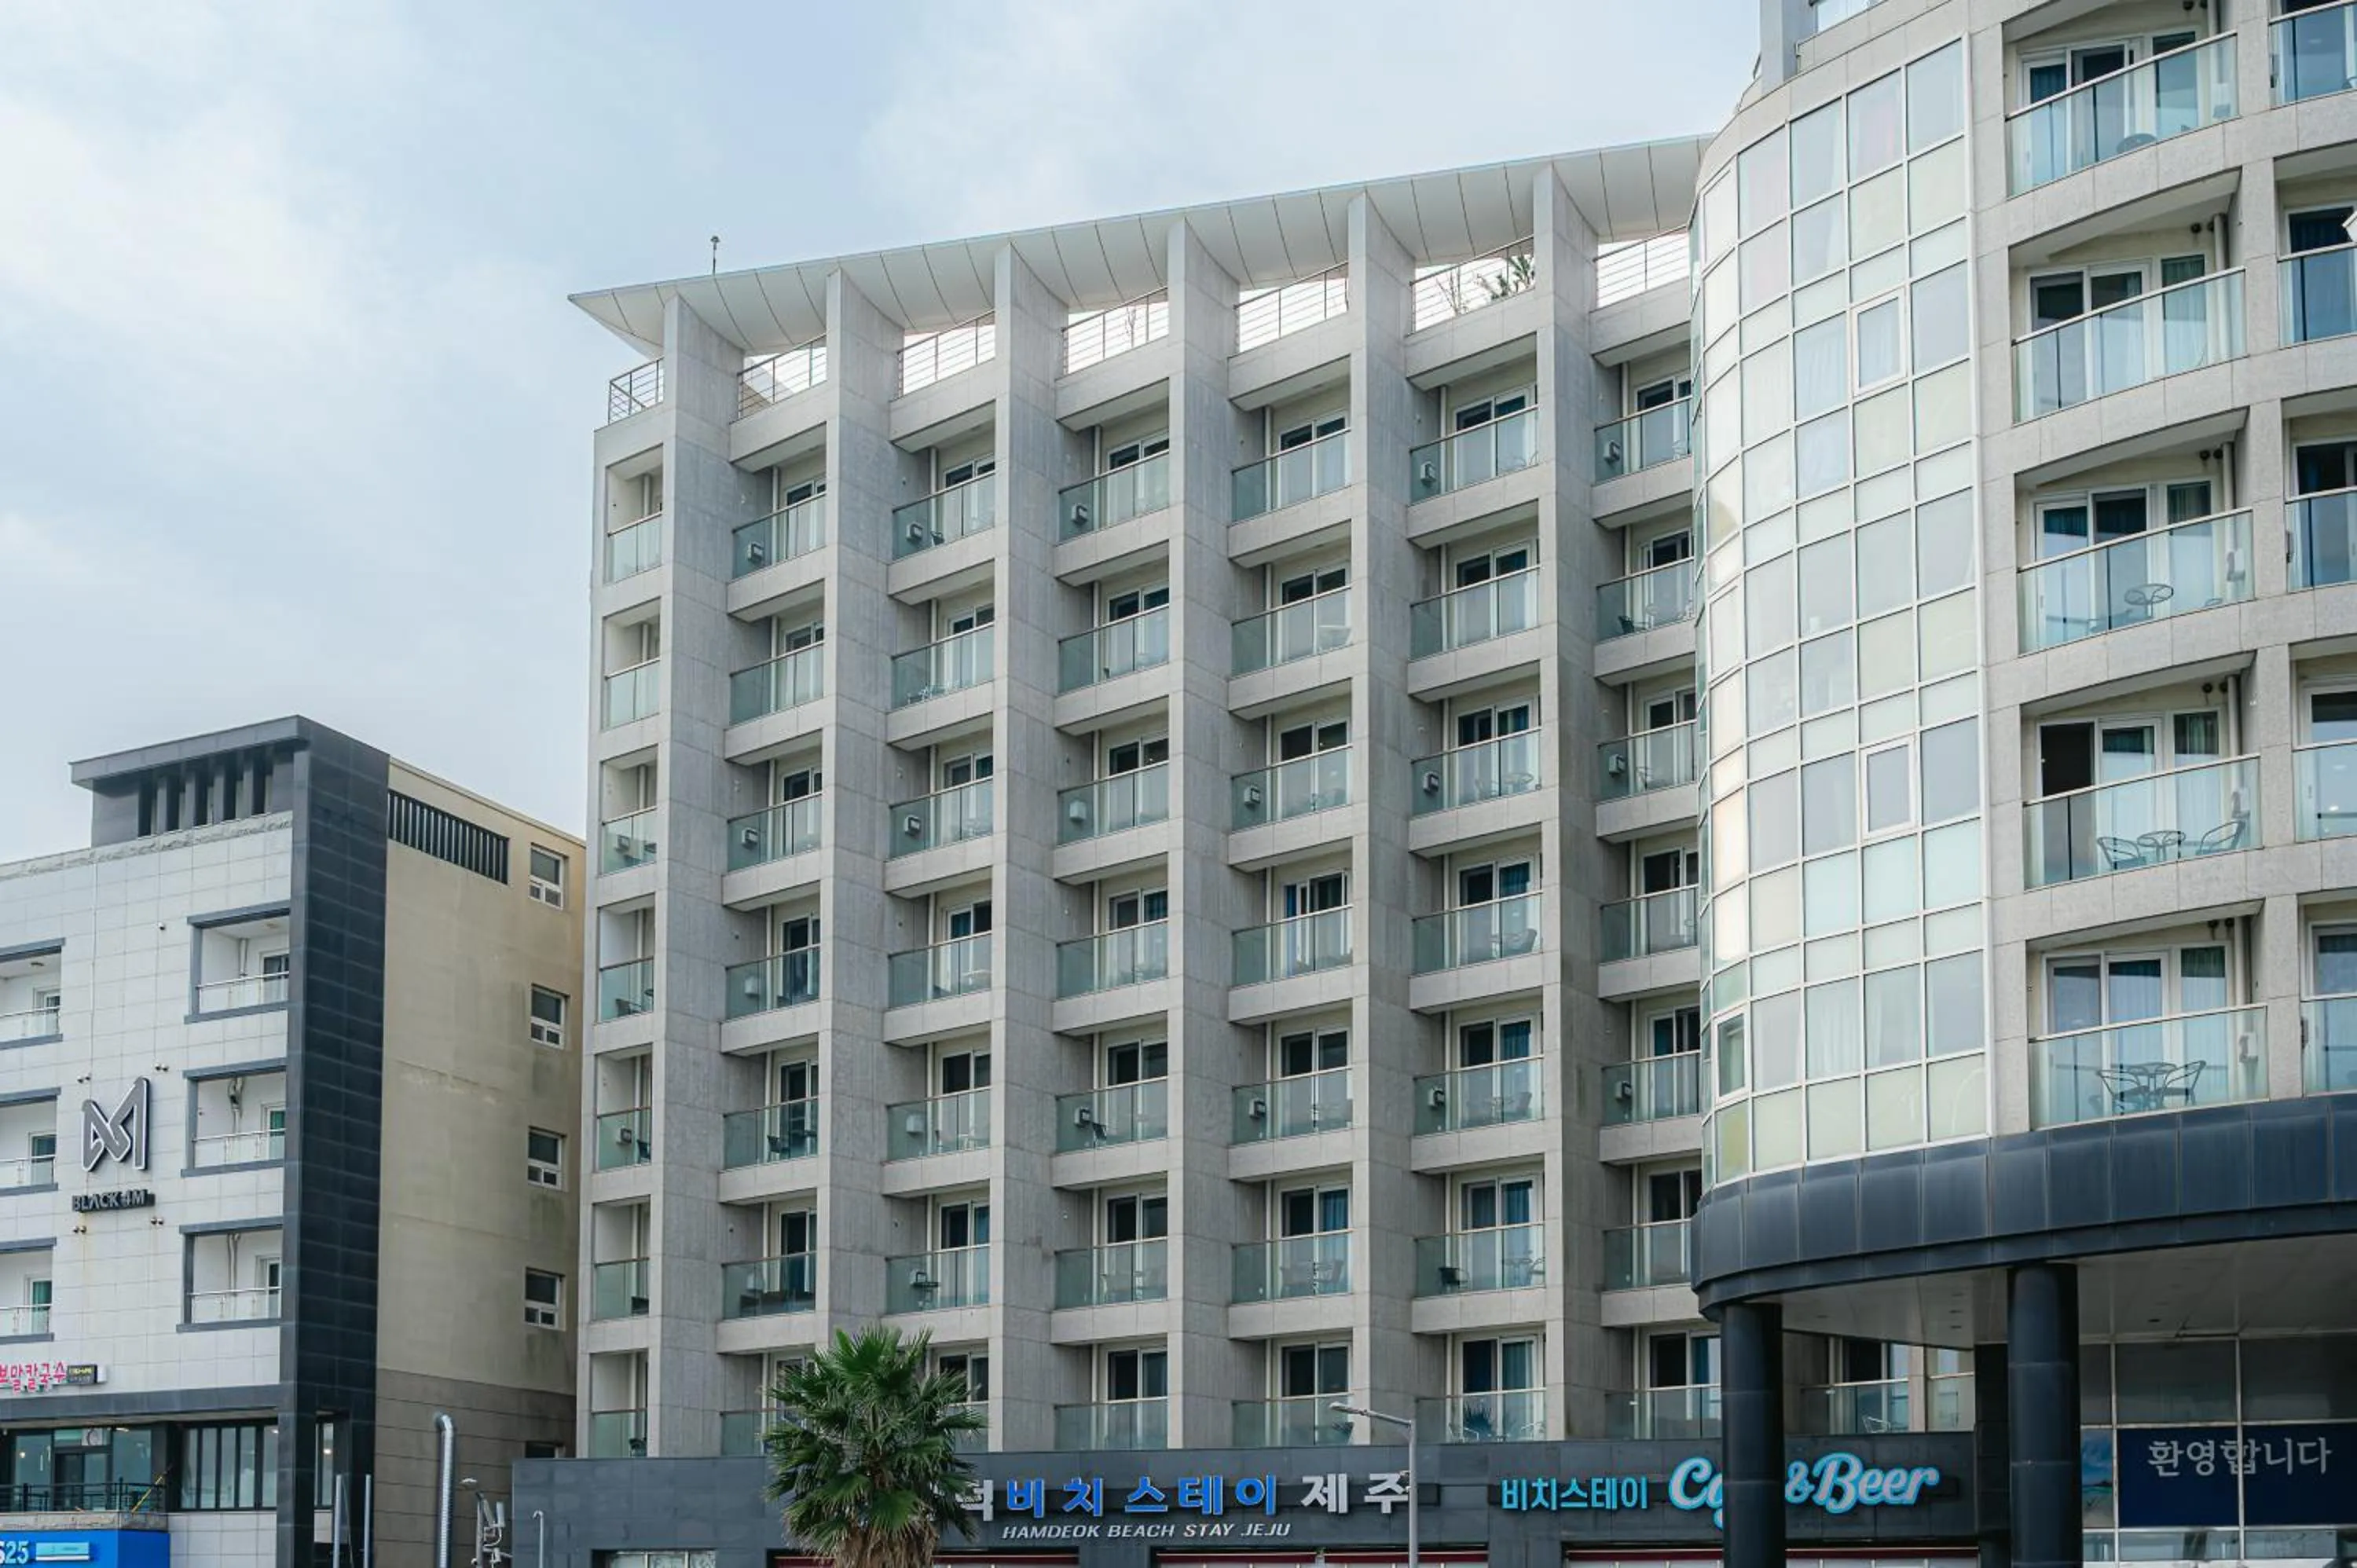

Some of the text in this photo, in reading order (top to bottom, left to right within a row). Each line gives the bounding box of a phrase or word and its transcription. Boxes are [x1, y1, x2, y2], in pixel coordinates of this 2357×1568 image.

[73, 1191, 123, 1212] BLACK
[2147, 1437, 2333, 1478] 환영합니다
[1300, 1472, 1409, 1515] 제주
[1501, 1476, 1648, 1511] 비치스테이
[1002, 1522, 1292, 1539] HAMDEOK BEACH STAY JEJU
